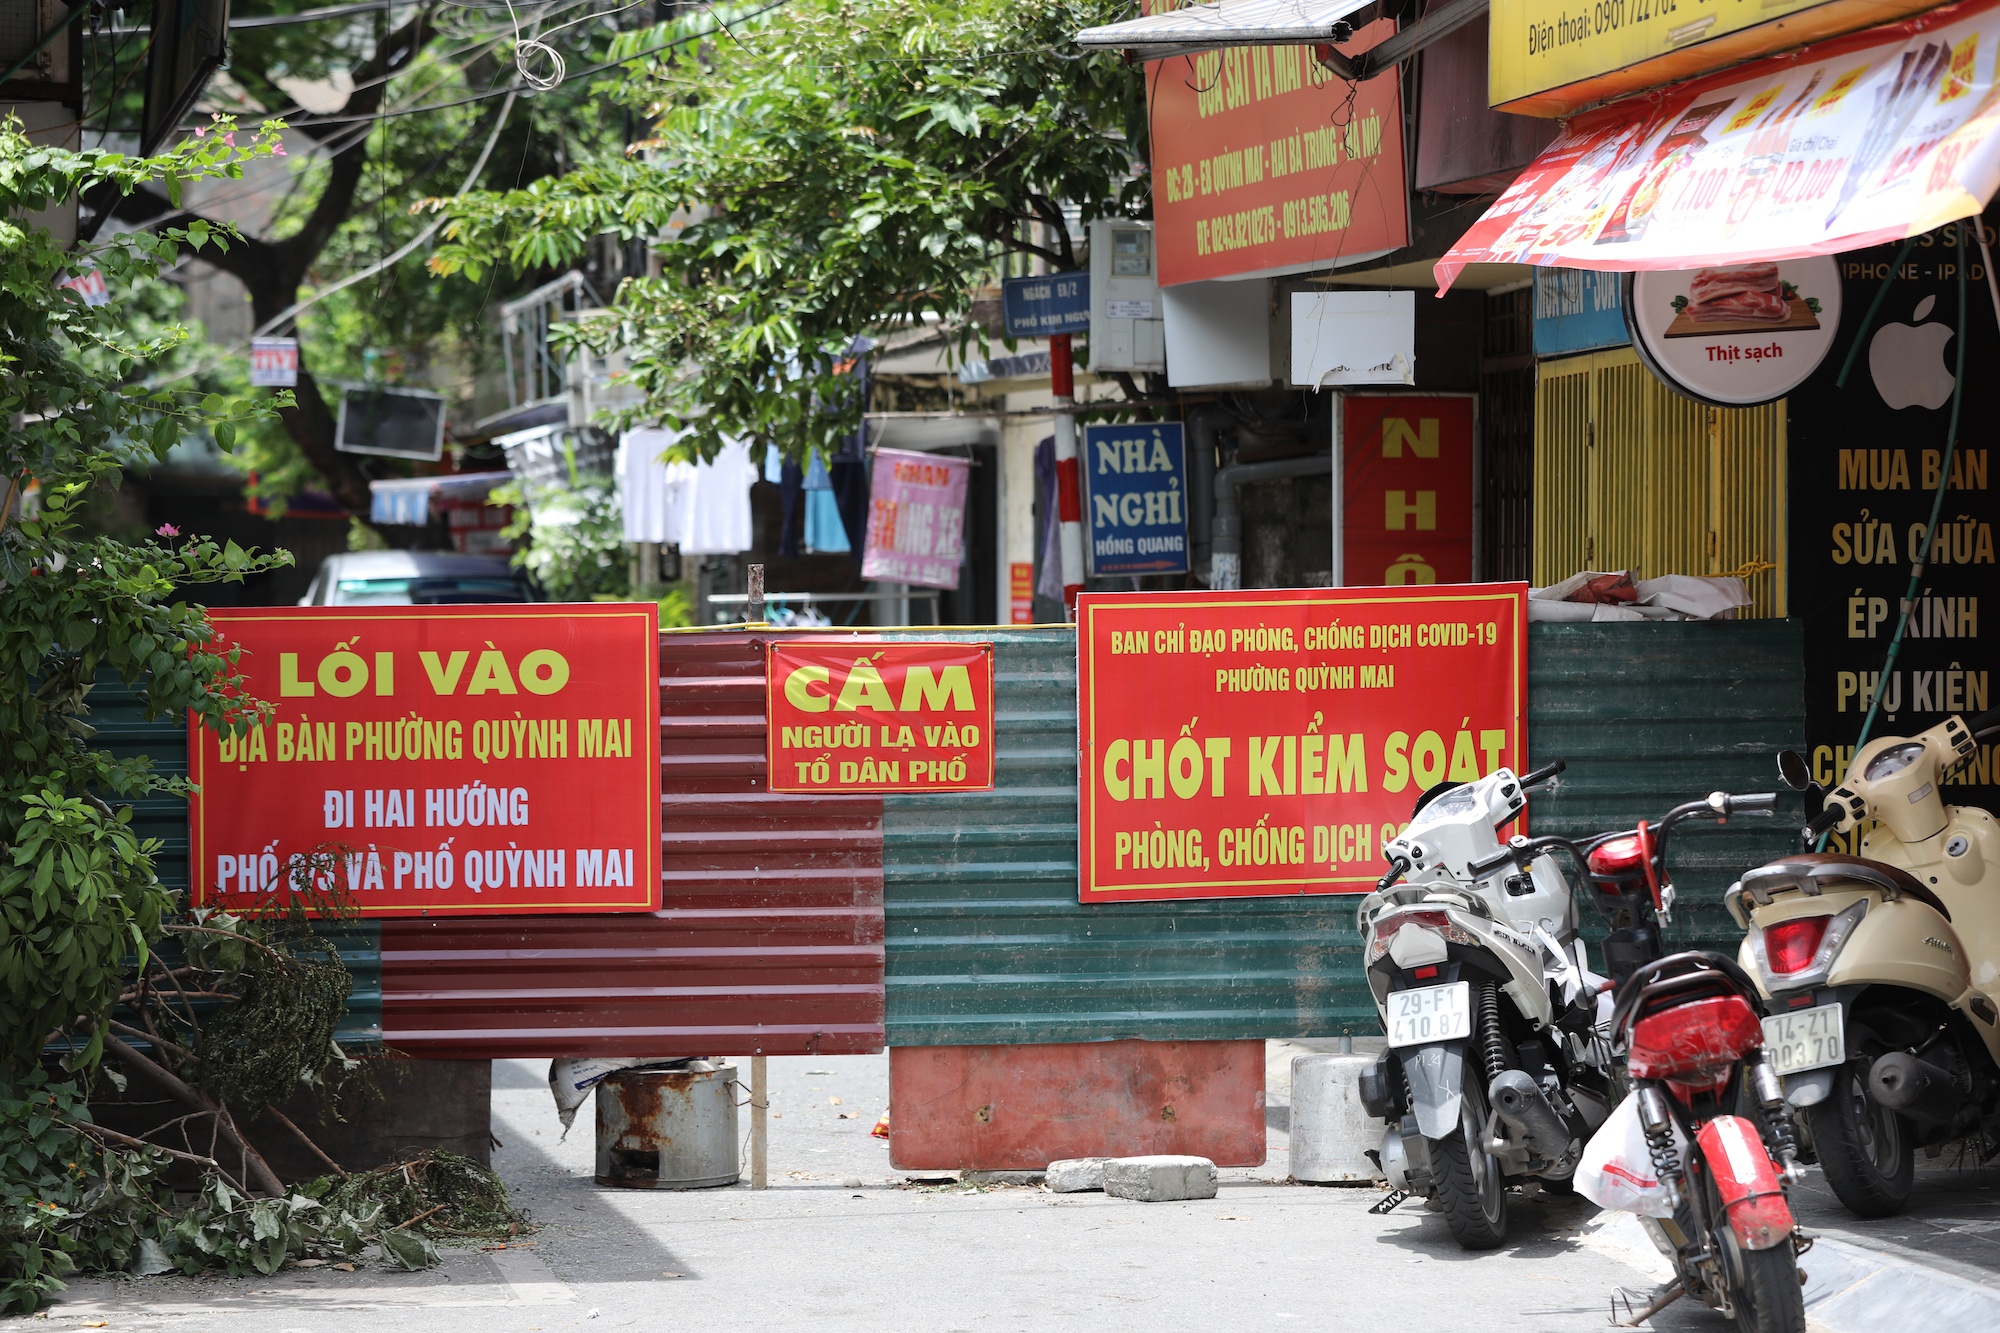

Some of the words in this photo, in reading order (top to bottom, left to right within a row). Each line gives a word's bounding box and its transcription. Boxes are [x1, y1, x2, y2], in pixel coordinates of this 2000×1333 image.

[1529, 20, 1554, 58] Điện
[1558, 9, 1591, 47] thoại:
[1270, 139, 1288, 179] HAI
[1289, 127, 1303, 174] BÀ
[1705, 345, 1741, 366] Thịt
[1744, 342, 1783, 366] sạch
[1096, 429, 1174, 475] NHÀ
[1838, 449, 1911, 490] MUA
[1094, 477, 1182, 528] NGHỈ
[1096, 534, 1134, 556] HỒNG
[1137, 535, 1184, 555] QUANG
[1831, 508, 1897, 564] SỬA
[1848, 588, 1889, 638] ÉP
[1900, 588, 1978, 638] KÍNH
[1111, 631, 1149, 655] BAN
[1154, 622, 1185, 653] CHỈ
[1190, 628, 1227, 658] ĐẠO
[1232, 621, 1299, 655] PHÒNG,
[1304, 618, 1365, 650] CHỐNG
[1370, 624, 1412, 652] DỊCH
[1416, 622, 1497, 648] COVID-19
[280, 636, 394, 698] LỐI
[419, 640, 570, 696] VÀO
[784, 651, 976, 712] CẤM
[1216, 661, 1290, 693] PHƯỜNG
[1295, 661, 1355, 694] QUỲNH
[1360, 664, 1394, 689] MAI
[1837, 670, 1902, 722] PHỤ
[276, 714, 335, 762] BÀN
[346, 711, 462, 761] PHƯỜNG
[472, 711, 568, 764] QUỲNH
[577, 719, 632, 757] MAI
[782, 720, 871, 748] NGƯỜI
[881, 725, 916, 753] LẠ
[924, 720, 980, 748] VÀO
[1103, 716, 1231, 802] CHỐT
[1248, 710, 1368, 796] KIỂM
[1382, 716, 1506, 793] SOÁT
[795, 752, 831, 784] TỔ
[840, 756, 899, 784] DÂN
[909, 752, 968, 783] PHỐ
[323, 790, 353, 829] ĐI
[364, 789, 415, 827] HAI
[425, 780, 529, 827] HƯỚNG
[217, 840, 279, 893] PHỐ
[345, 843, 385, 890] VÀ
[393, 837, 455, 889] PHỐ
[464, 842, 566, 893] QUỲNH
[576, 849, 634, 887] MAI
[1115, 820, 1211, 872] PHÒNG,
[1218, 813, 1305, 867] CHỐNG
[1313, 824, 1371, 872] DỊCH
[1400, 987, 1454, 1017] 29-F1
[1775, 1011, 1828, 1043] 14-Z1
